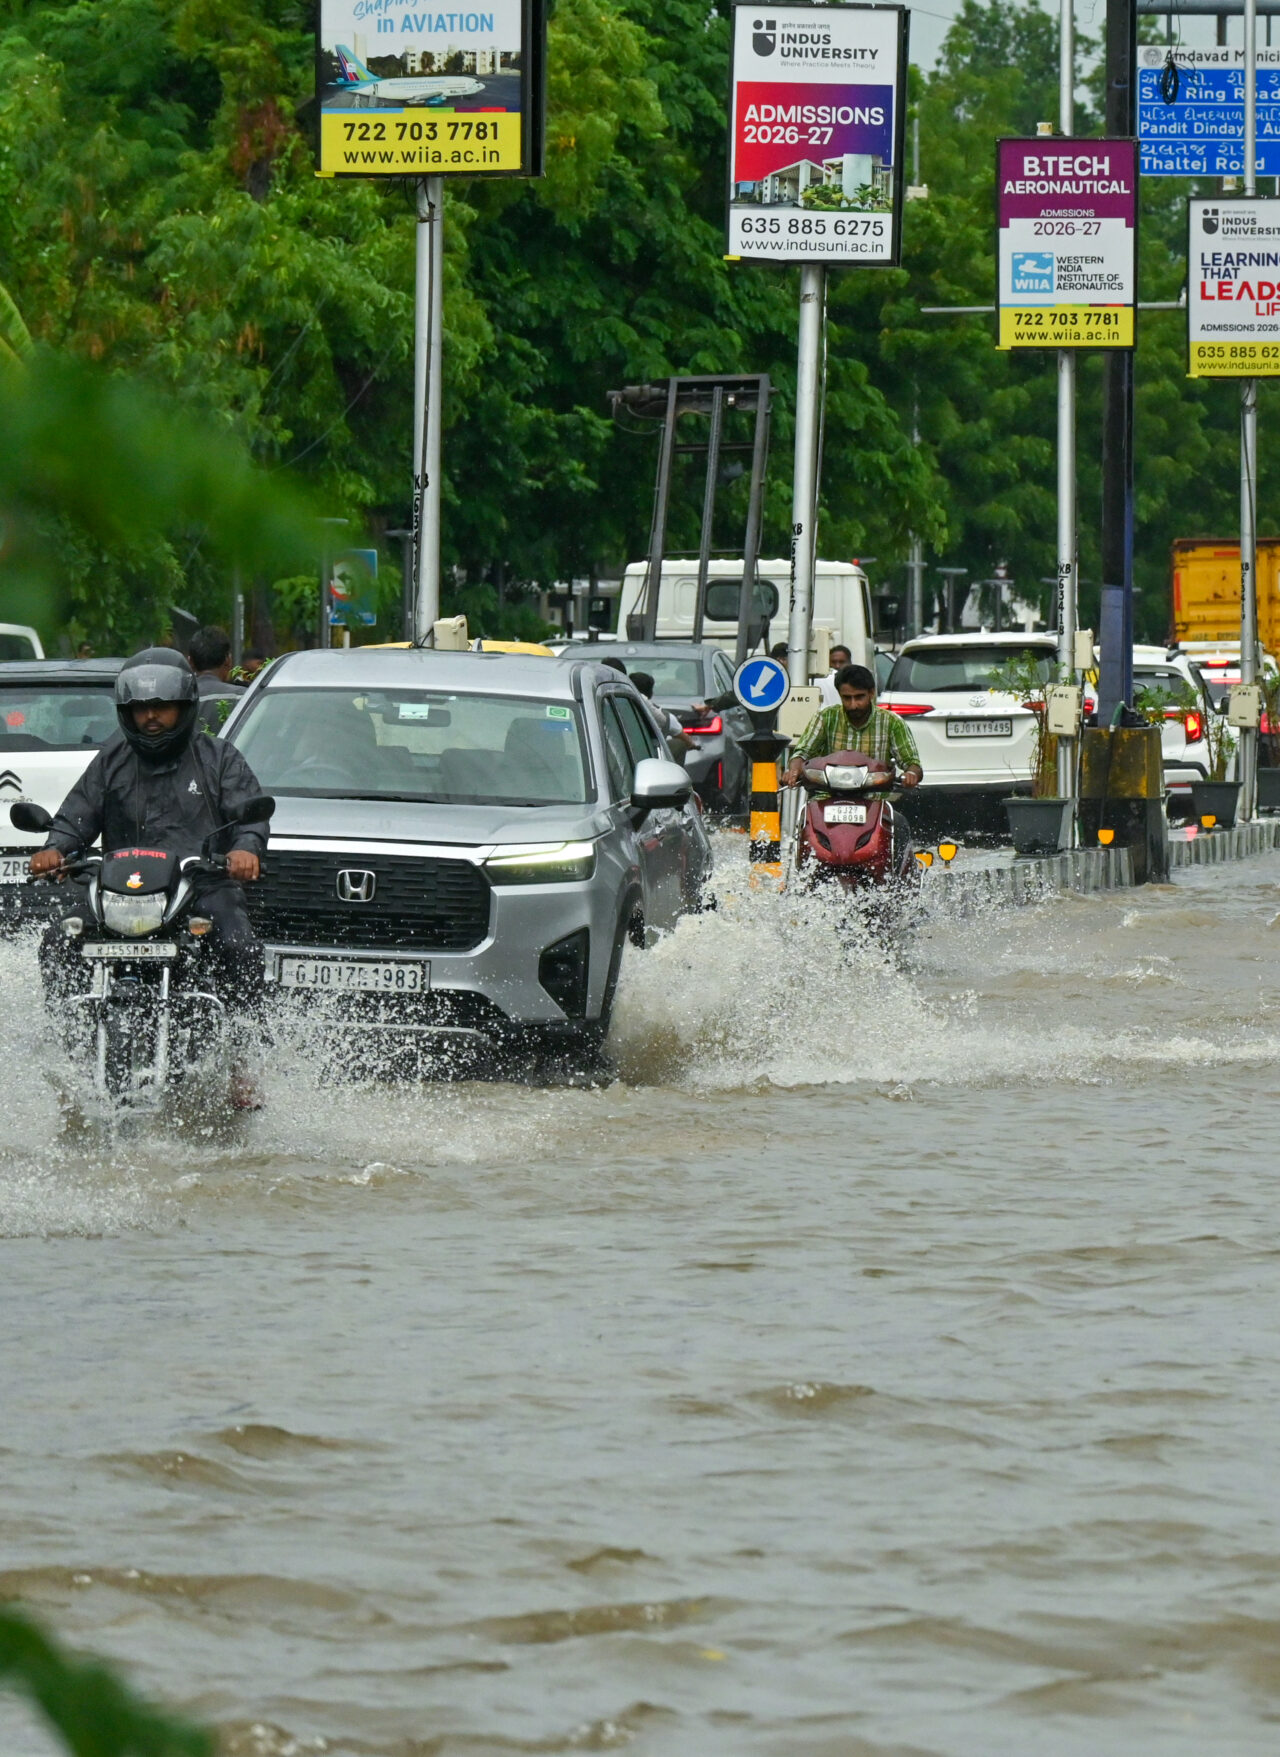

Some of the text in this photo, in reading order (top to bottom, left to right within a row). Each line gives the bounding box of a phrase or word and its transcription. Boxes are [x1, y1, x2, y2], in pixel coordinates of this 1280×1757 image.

[377, 14, 494, 32] in AVIATION
[781, 34, 831, 44] INDUS
[781, 47, 878, 60] UNIVERSITY
[1186, 87, 1226, 101] Ring
[744, 105, 884, 125] ADMISSIONS
[344, 122, 498, 140] 722 703 7781
[744, 125, 833, 145] 2026-27
[1141, 122, 1187, 134] Pandit
[1194, 122, 1257, 136] Dinday
[344, 147, 499, 163] www.wiia.ac.in
[1024, 156, 1109, 176] B.TECH
[1141, 157, 1265, 172] Thaltej Rod
[1004, 181, 1130, 194] AERONAUTICAL
[1040, 209, 1095, 217] ADMISSIONS
[741, 218, 883, 236] 635 885 6275
[1034, 222, 1101, 235] 2026-27
[741, 239, 883, 253] www.indusuni.ac.in
[1201, 268, 1240, 279] THAT
[1015, 279, 1050, 290] WIIA
[1015, 313, 1119, 325] 722 703 7781
[1015, 329, 1119, 340] www.wiia.ac.in
[1198, 347, 1224, 358] 635
[1230, 347, 1256, 357] 885
[1059, 563, 1071, 574] KB
